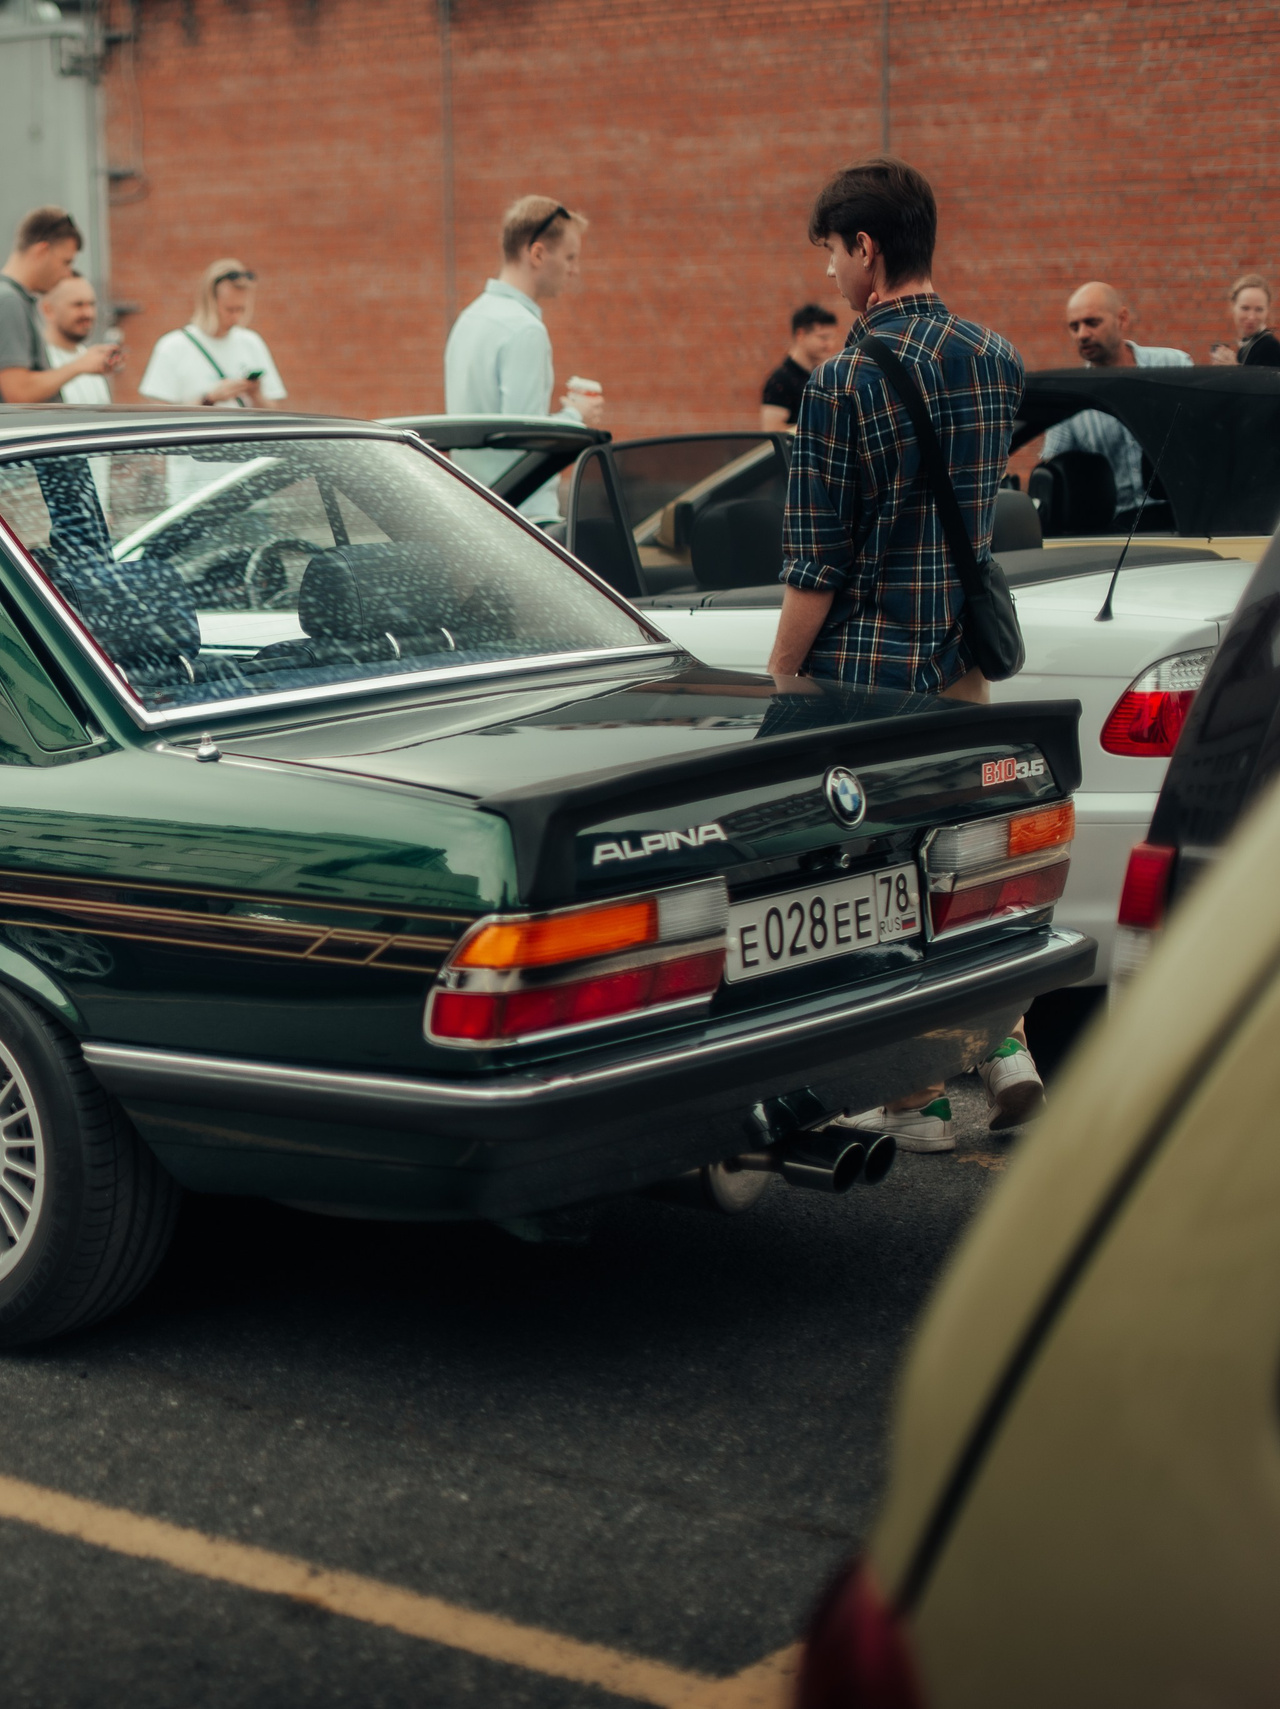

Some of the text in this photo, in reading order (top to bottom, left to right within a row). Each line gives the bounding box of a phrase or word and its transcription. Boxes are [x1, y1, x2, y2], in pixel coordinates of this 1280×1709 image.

[592, 823, 728, 865] ALPINA
[879, 872, 909, 918] 78
[880, 917, 902, 935] RUS
